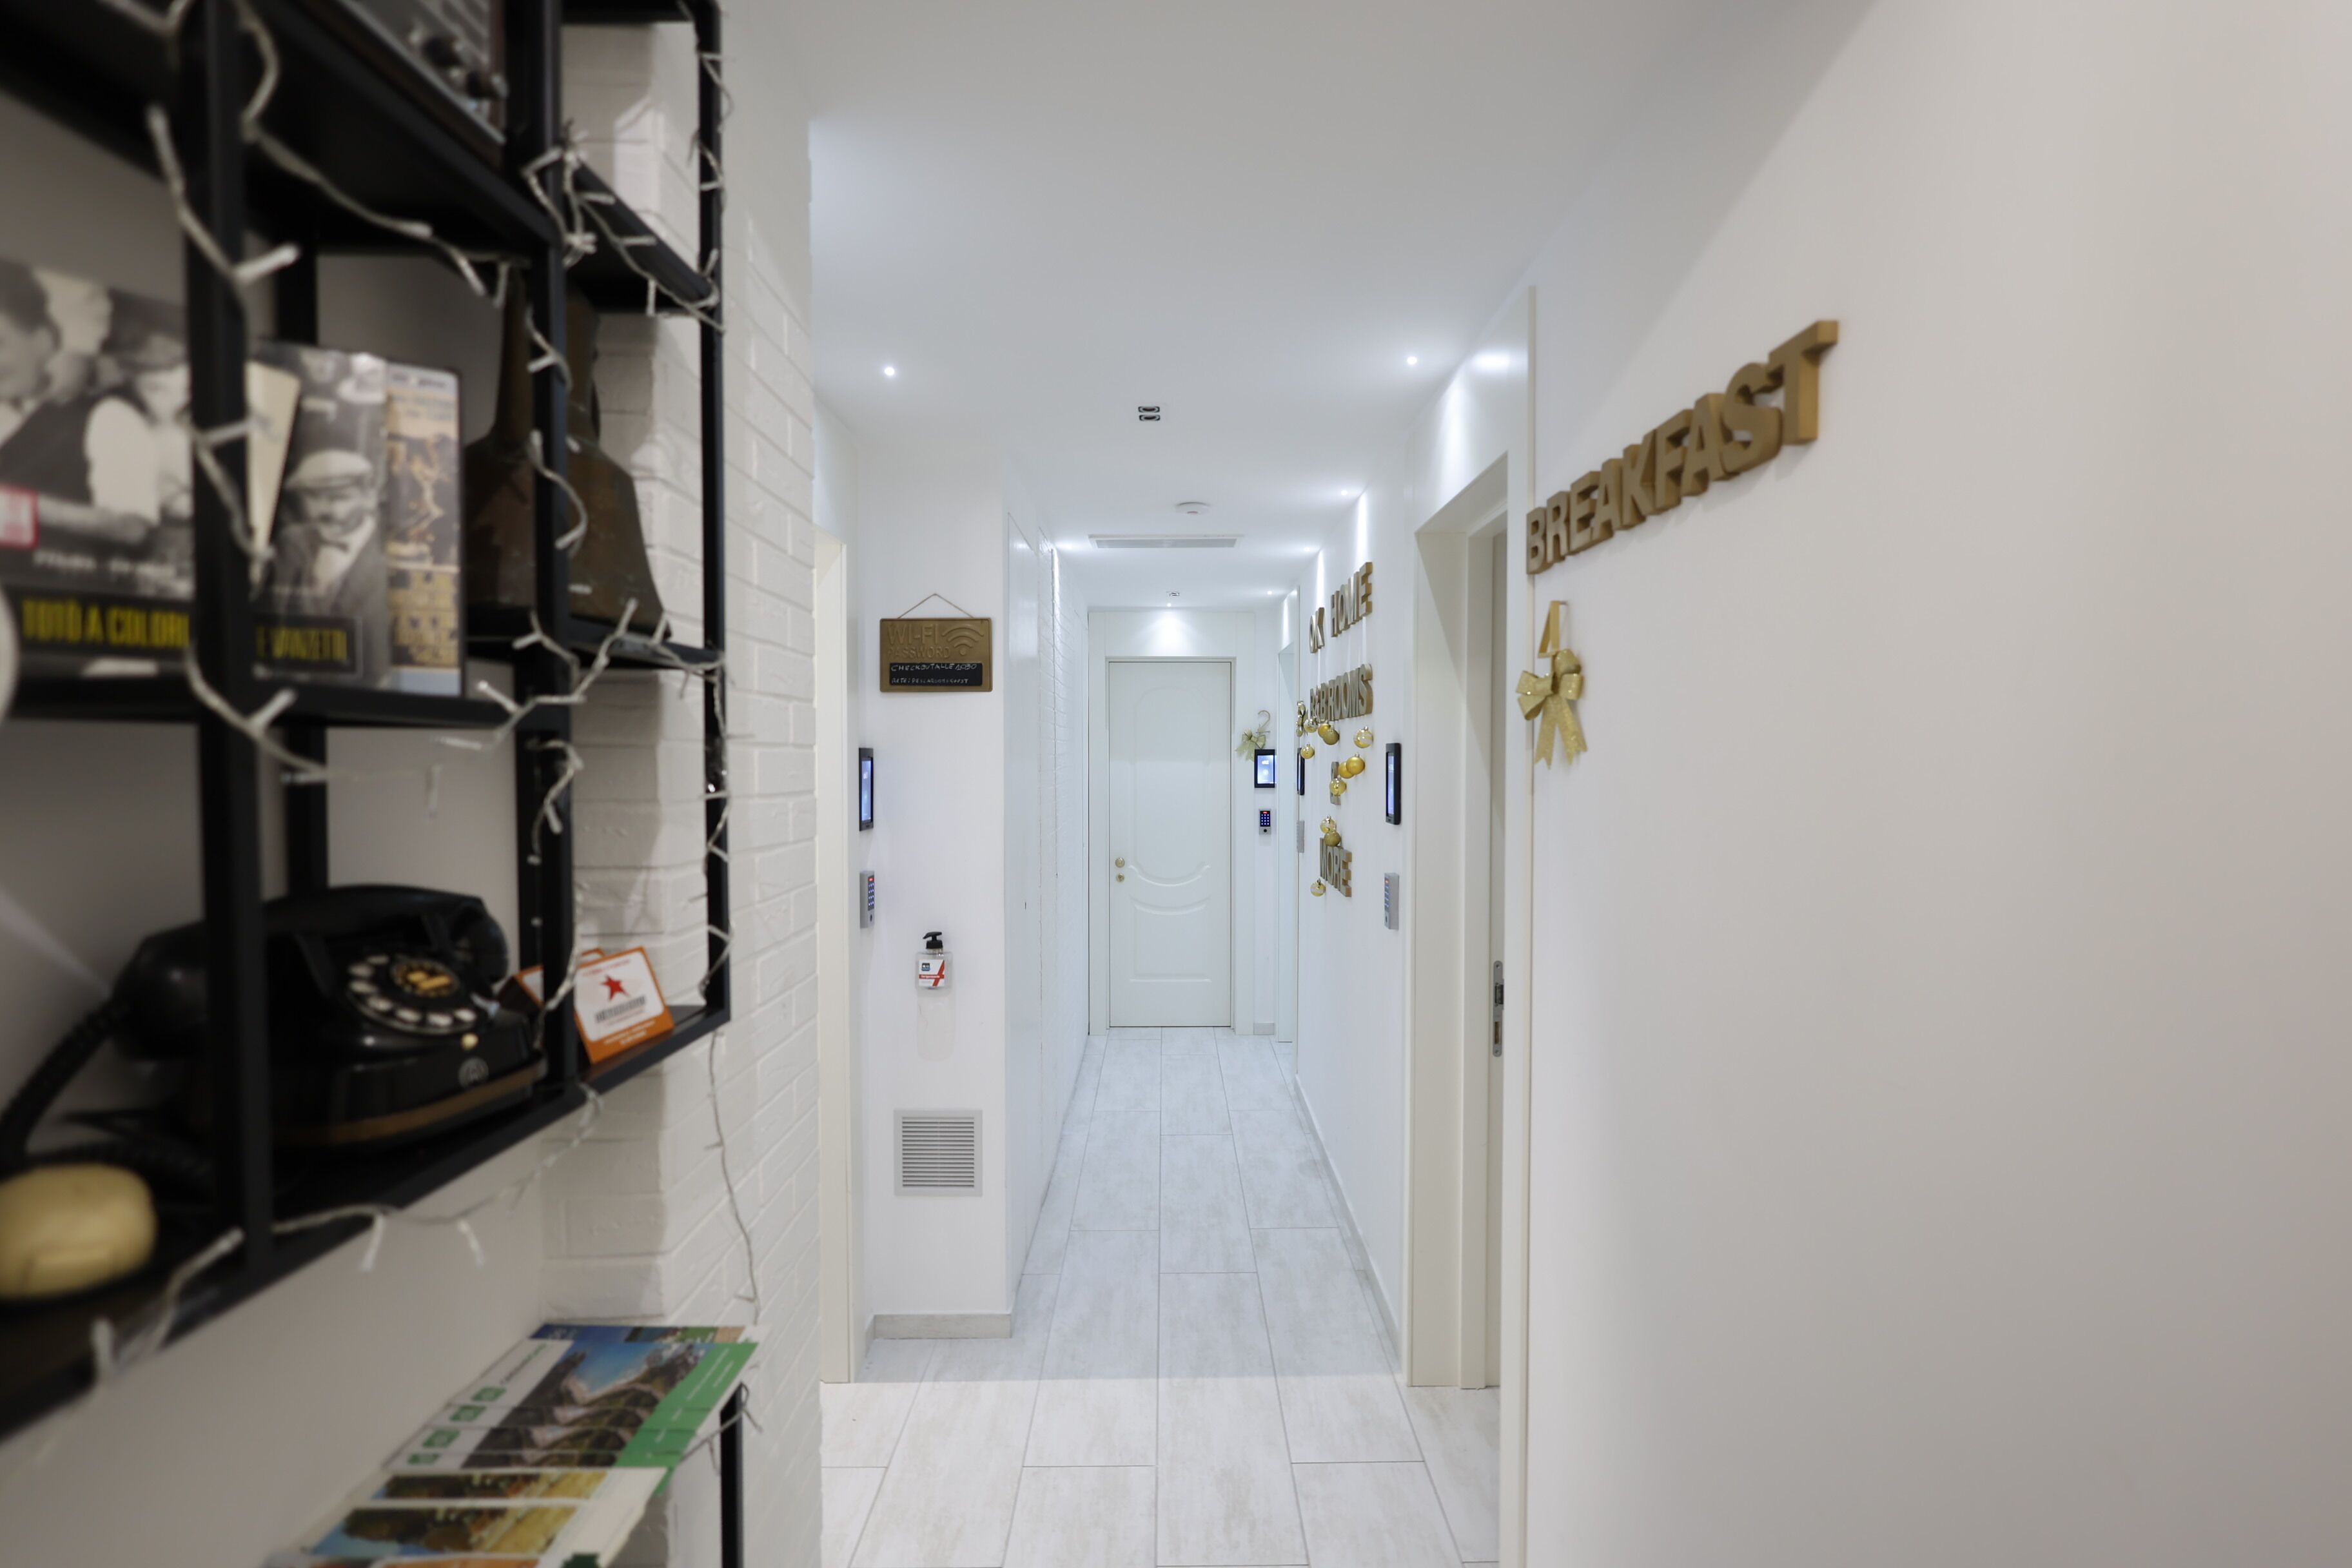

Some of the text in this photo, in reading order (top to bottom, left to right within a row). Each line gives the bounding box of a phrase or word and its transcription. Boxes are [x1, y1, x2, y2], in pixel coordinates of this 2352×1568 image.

[1526, 319, 1839, 574] BREAKFAST
[887, 623, 939, 645] WI-FI
[1309, 562, 1373, 653] OK HOME
[887, 646, 950, 658] PASSWORD
[1319, 838, 1352, 897] MORE
